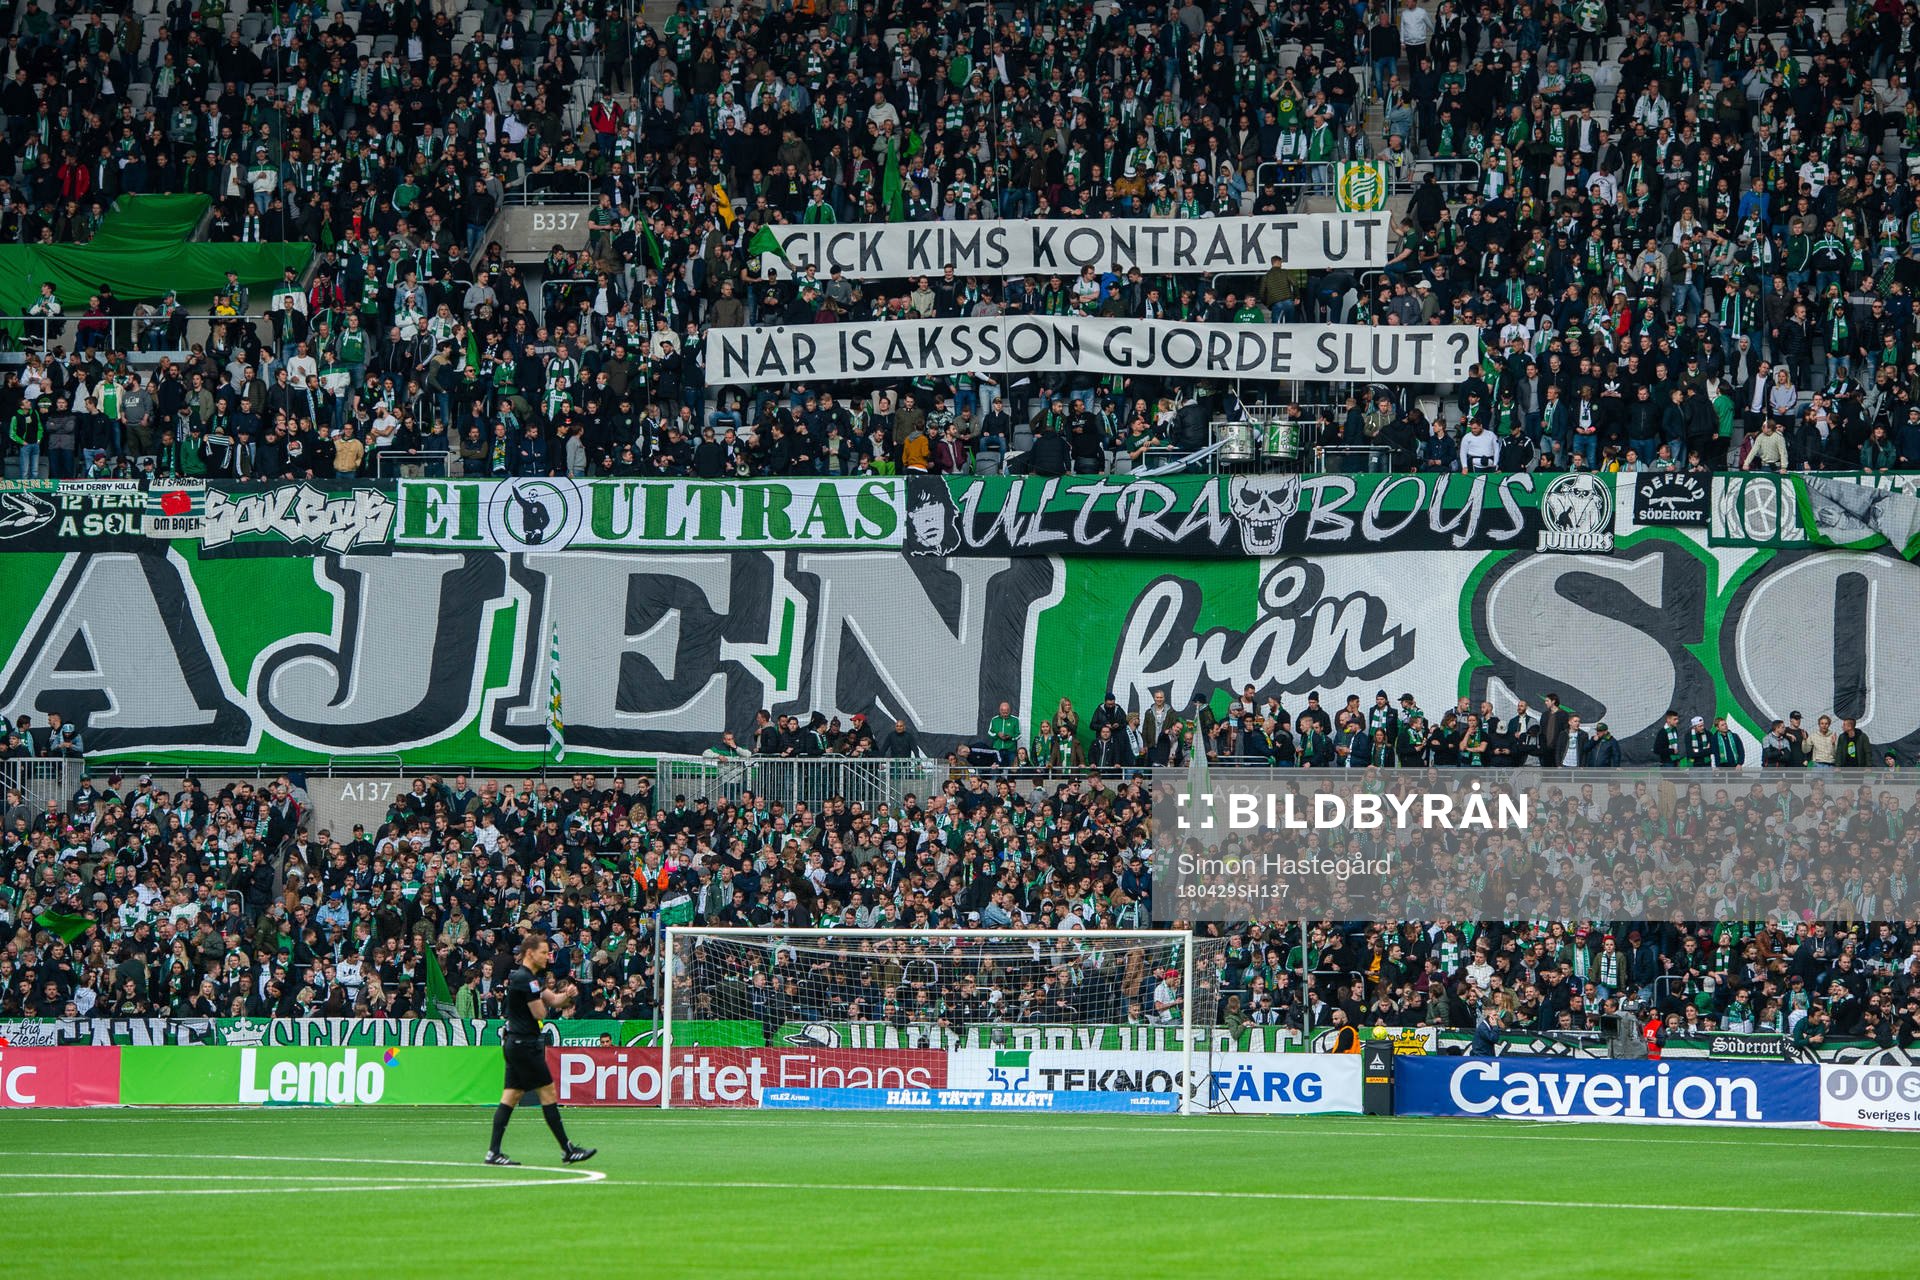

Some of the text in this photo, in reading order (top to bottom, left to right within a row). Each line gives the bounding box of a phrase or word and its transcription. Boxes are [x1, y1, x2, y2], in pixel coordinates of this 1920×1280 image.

[533, 213, 580, 231] B337
[781, 219, 1381, 272] GICK KIMS KONTRAKT UT
[721, 326, 817, 379] NÄR
[838, 322, 1081, 373] ISAKSSON
[1102, 326, 1293, 373] GJORDE
[1315, 332, 1434, 376] SLUT
[86, 483, 112, 491] DERBY
[1640, 473, 1705, 499] DEFEND
[589, 482, 899, 541] ULTRAS
[960, 473, 1534, 548] ULTRA BOYS
[1639, 508, 1703, 520] SÖDERORT
[58, 516, 78, 537] A
[154, 517, 200, 532] OM BAJEN
[1536, 529, 1614, 552] JUNIORS
[340, 782, 392, 801] A137
[1712, 1036, 1782, 1055] Söderort
[239, 1047, 385, 1104] Lendo
[560, 1053, 931, 1101] Prioritet Finans
[1040, 1063, 1322, 1103] TEKNOS FÄRG
[886, 1089, 1054, 1107] HÅLL TÄTT BAKÅT!
[1450, 1061, 1763, 1120] Caverion
[1857, 1108, 1911, 1122] Sveriges
